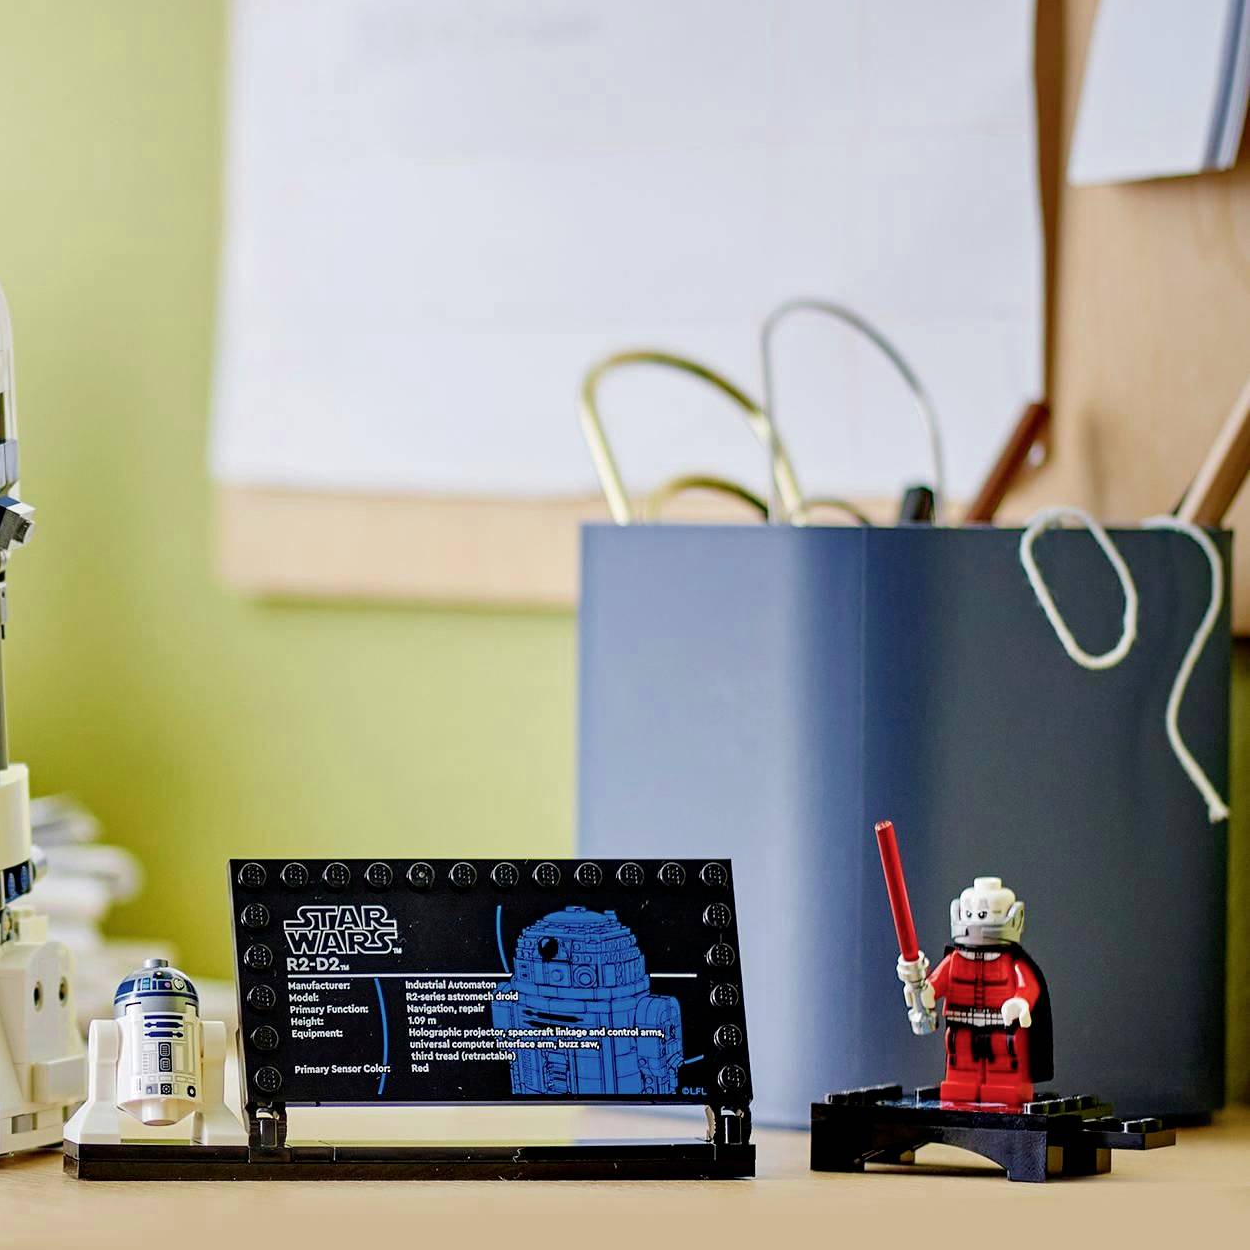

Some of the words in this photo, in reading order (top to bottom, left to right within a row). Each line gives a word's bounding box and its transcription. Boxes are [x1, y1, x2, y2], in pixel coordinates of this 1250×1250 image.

[283, 905, 397, 930] STAR
[288, 981, 350, 991] Manufacturer:
[405, 980, 446, 990] Industrial
[447, 980, 497, 990] Automaton
[289, 993, 319, 1002] Model:
[406, 992, 446, 1001] R2-series
[447, 992, 494, 1001] astromech
[495, 991, 519, 1001] droid
[290, 1005, 325, 1016] Primary
[327, 1005, 369, 1014] Function:
[407, 1004, 457, 1015] Navigation,
[458, 1004, 485, 1014] repair
[291, 1017, 324, 1028] Height:
[408, 1016, 426, 1025] 1.09
[292, 1029, 343, 1040] Equipment:
[409, 1028, 462, 1038] Holographic
[463, 1028, 506, 1038] projector,
[508, 1028, 554, 1038] spacecraft
[555, 1028, 588, 1039] linkage
[589, 1028, 605, 1037] and
[607, 1028, 638, 1037] control
[640, 1029, 665, 1039] arms,
[410, 1040, 450, 1049] universal
[451, 1041, 494, 1051] computer
[496, 1040, 535, 1049] interface
[537, 1041, 557, 1050] arm,
[558, 1040, 579, 1048] buzz
[580, 1041, 600, 1050] saw,
[411, 1052, 434, 1061] third
[435, 1052, 459, 1061] tread
[461, 1051, 516, 1062] (retractable)
[294, 1065, 330, 1076] Primary
[331, 1065, 362, 1074] Sensor
[363, 1064, 391, 1074] Color:
[411, 1064, 429, 1073] Red
